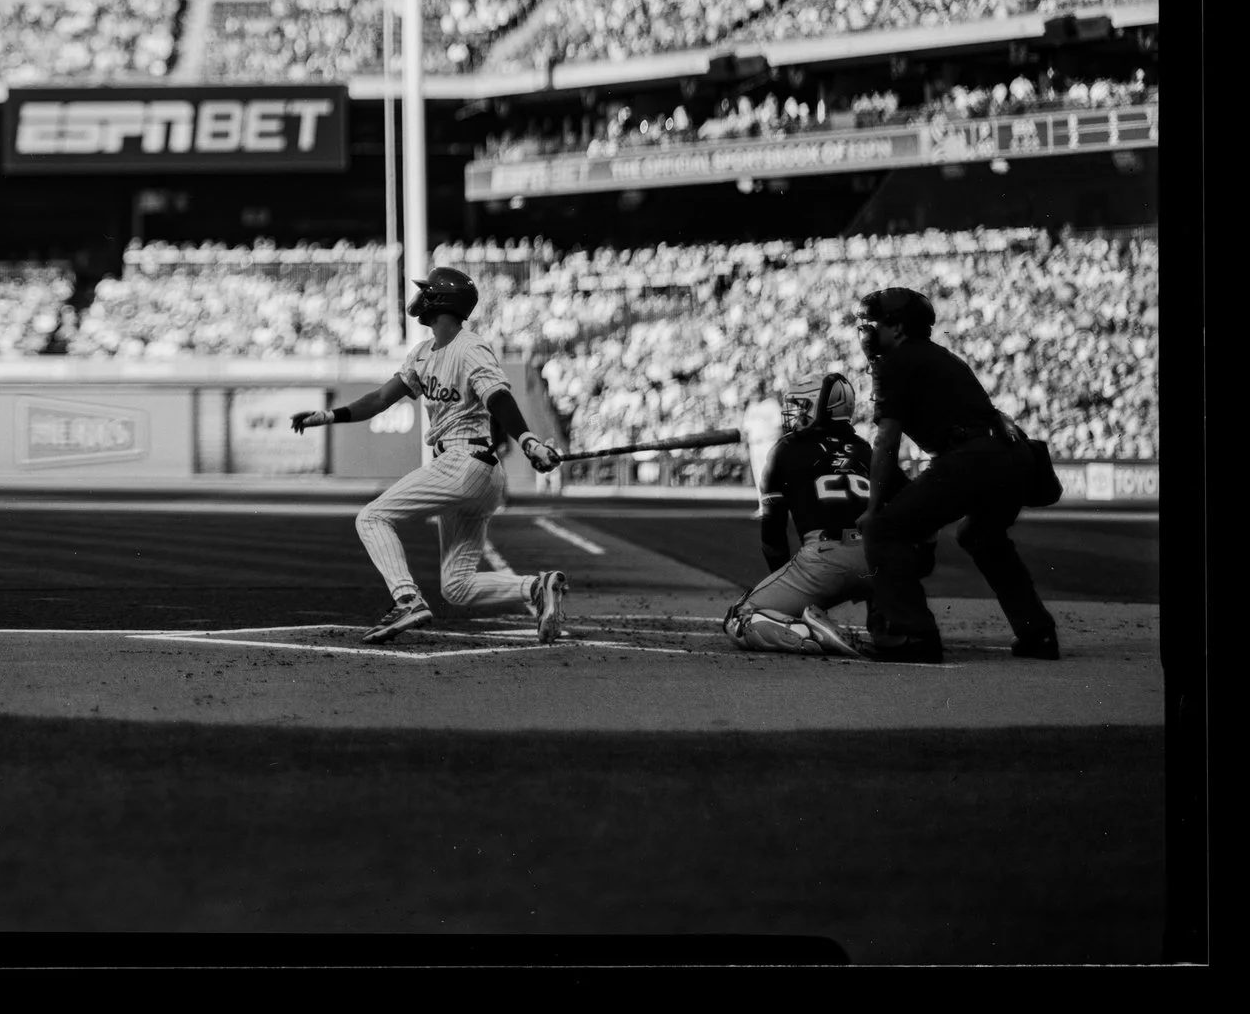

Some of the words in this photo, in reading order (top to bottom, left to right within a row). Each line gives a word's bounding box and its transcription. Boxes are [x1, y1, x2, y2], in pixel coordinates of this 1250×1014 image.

[16, 99, 195, 155] ESPN
[196, 97, 333, 154] BET
[422, 375, 461, 403] lies
